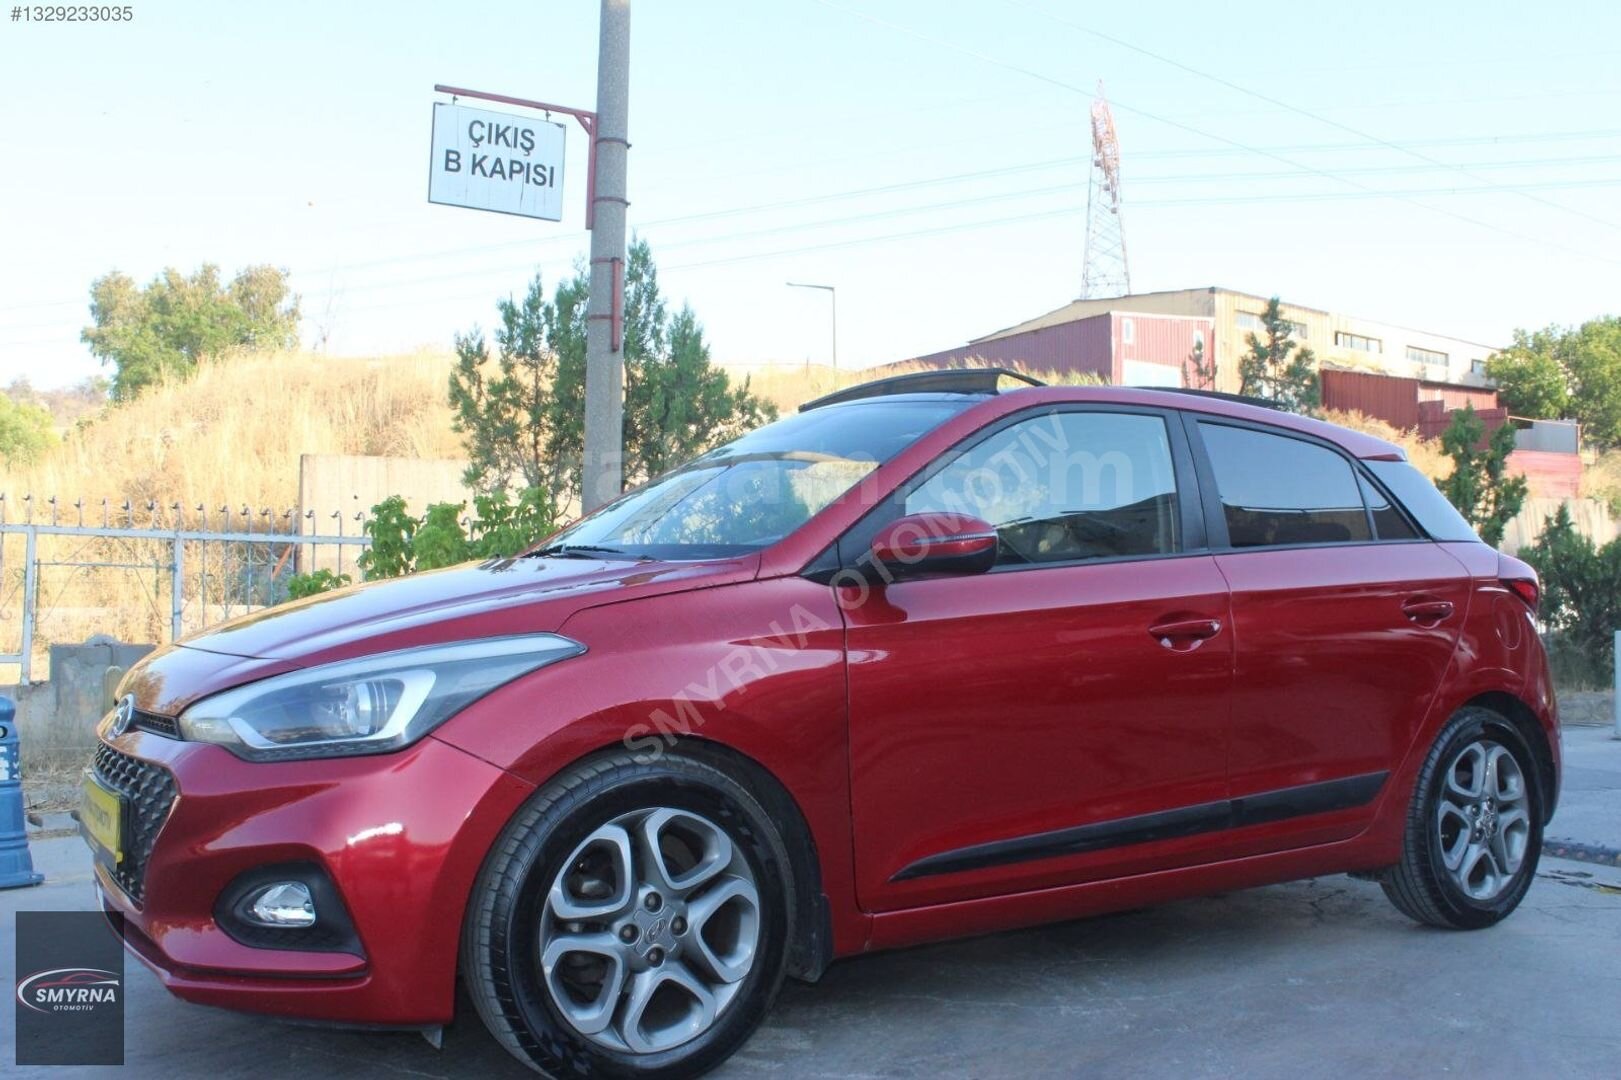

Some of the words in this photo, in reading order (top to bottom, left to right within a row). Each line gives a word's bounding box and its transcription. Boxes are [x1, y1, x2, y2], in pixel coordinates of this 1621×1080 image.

[468, 119, 536, 157] ÇIKIŞ
[444, 148, 462, 173] B
[471, 153, 555, 188] KAPISI
